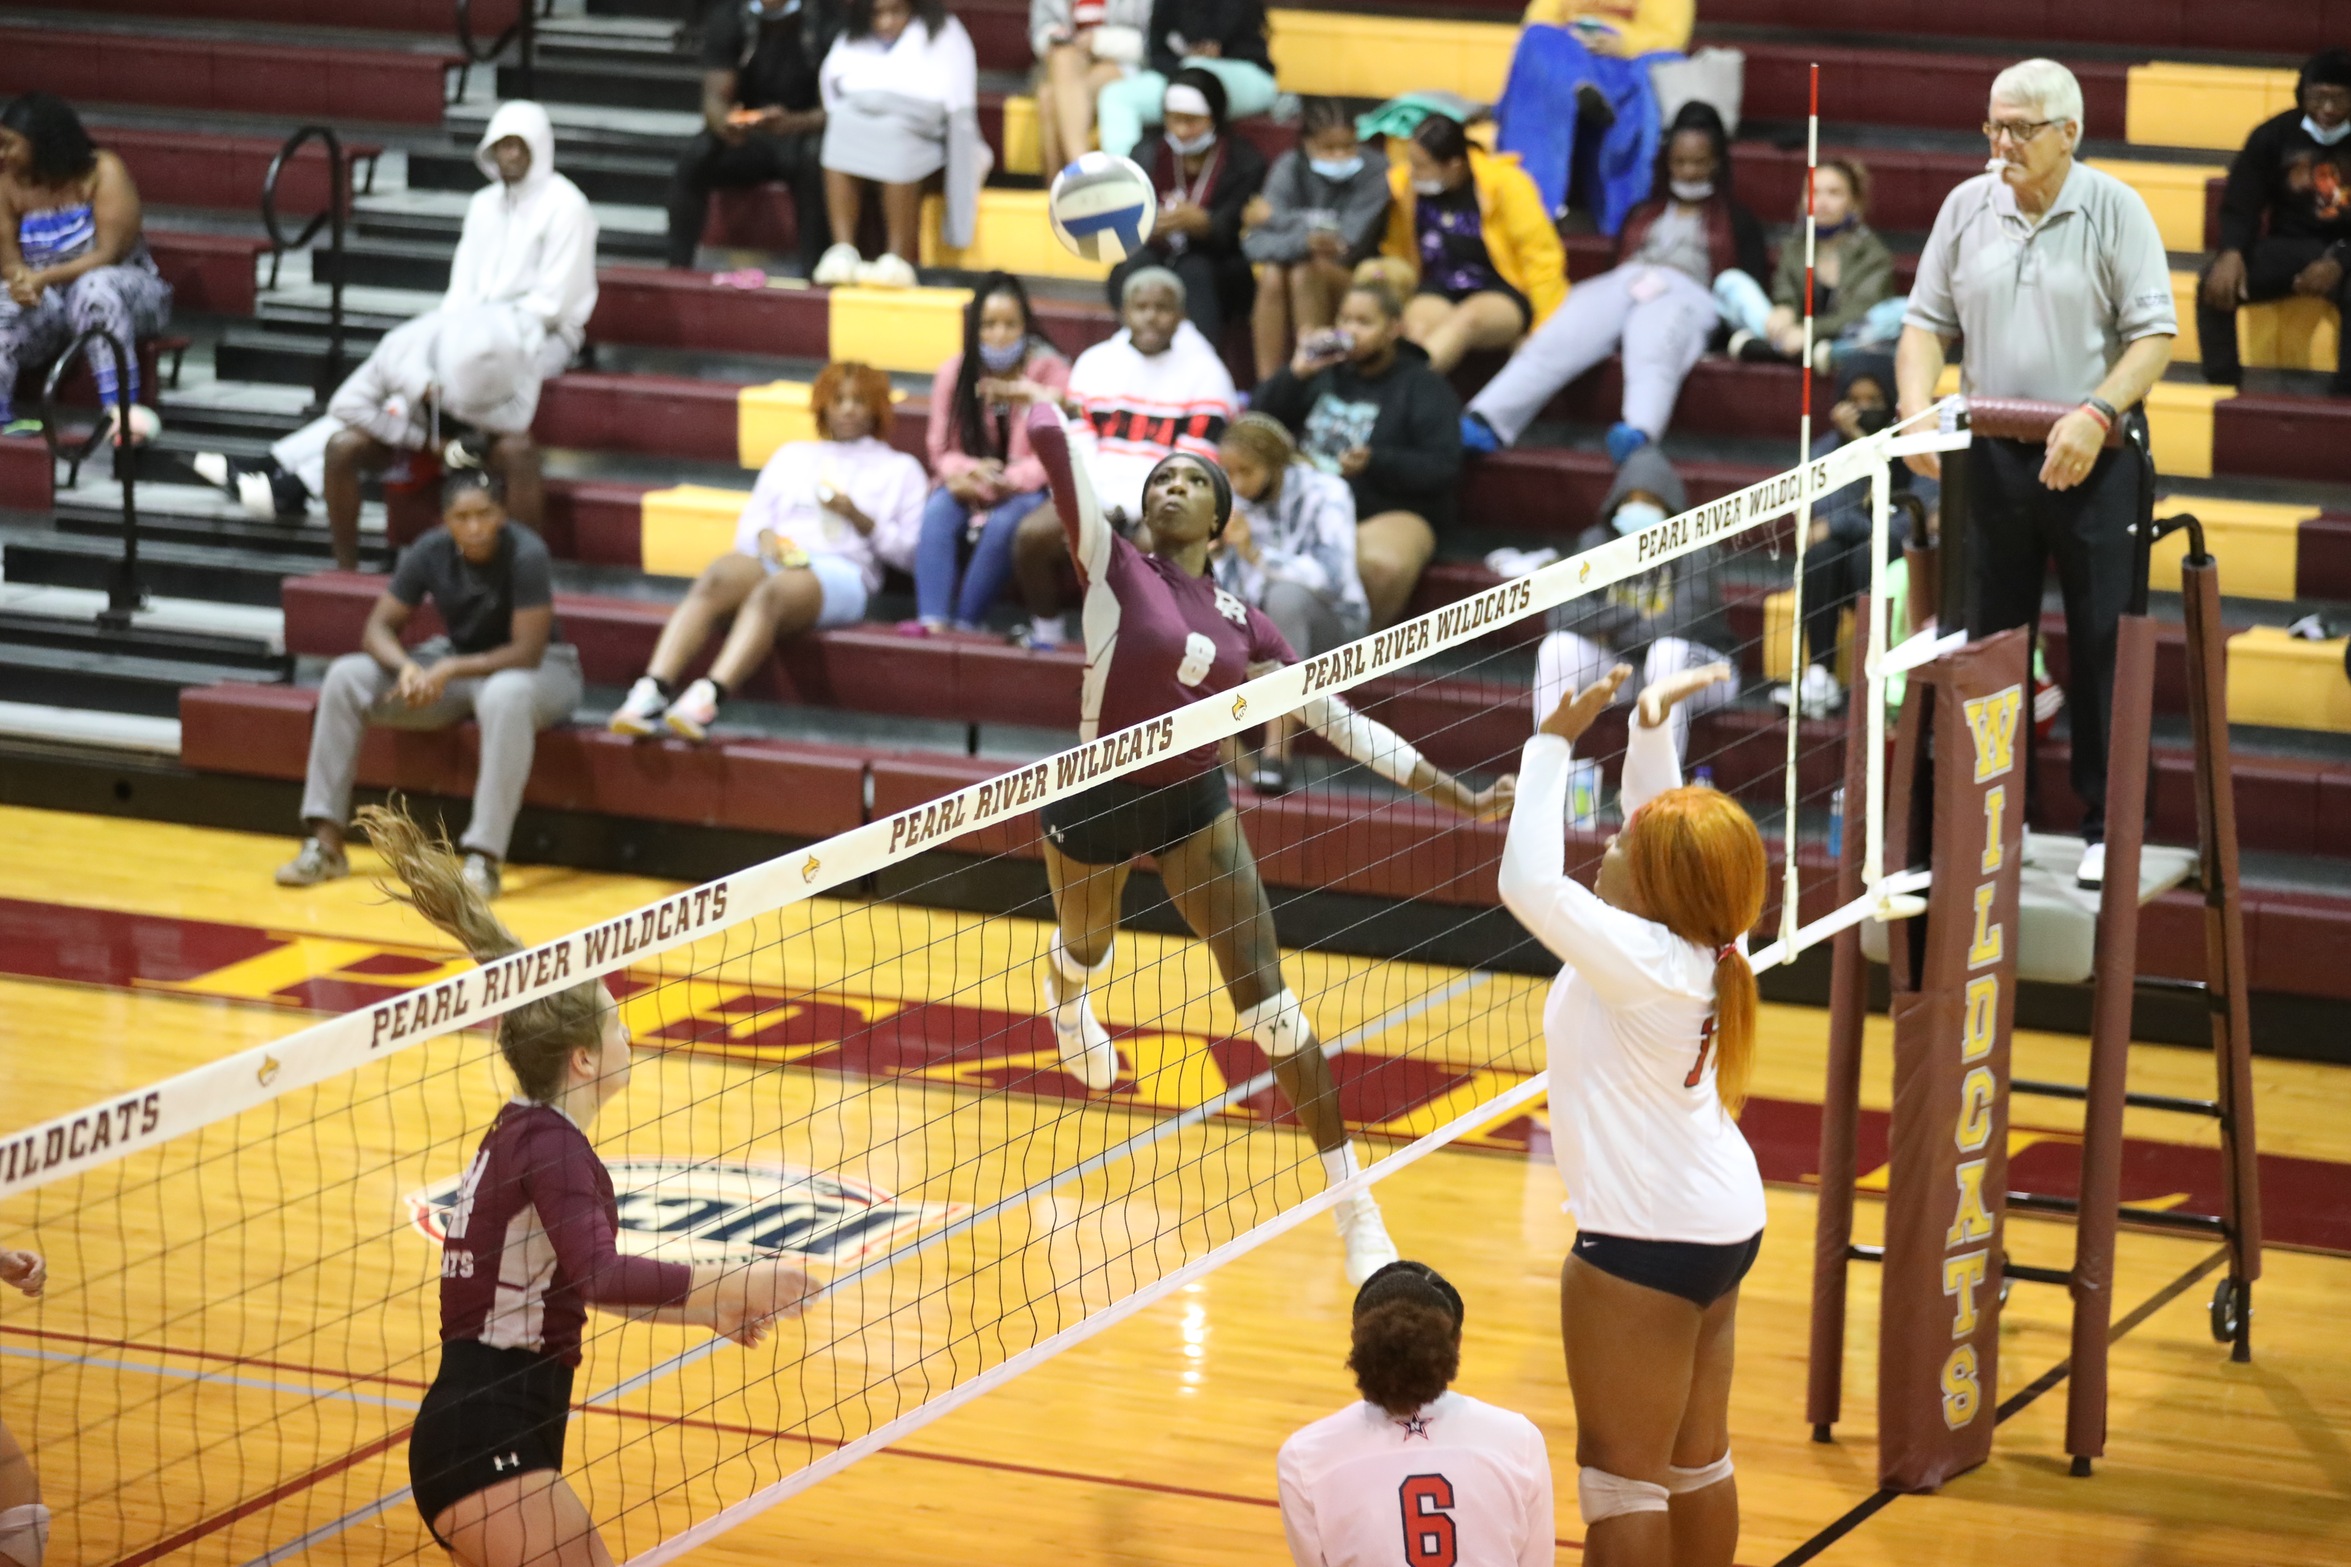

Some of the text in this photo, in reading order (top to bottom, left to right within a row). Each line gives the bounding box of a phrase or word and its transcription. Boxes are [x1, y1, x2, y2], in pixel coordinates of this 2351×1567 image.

[1638, 463, 1827, 562] PEARL RIVER WILDCTS
[1176, 631, 1217, 688] 8
[1302, 579, 1531, 696] PEARL RIVER WILDCATS
[888, 716, 1174, 855] PEARL RIVER WILDCATS
[371, 882, 728, 1049] PEARL RIVER WILDCATS
[1940, 684, 2022, 1431] WILDCATS
[0, 1091, 160, 1185] ILDCATS
[1398, 1472, 1458, 1567] 6
